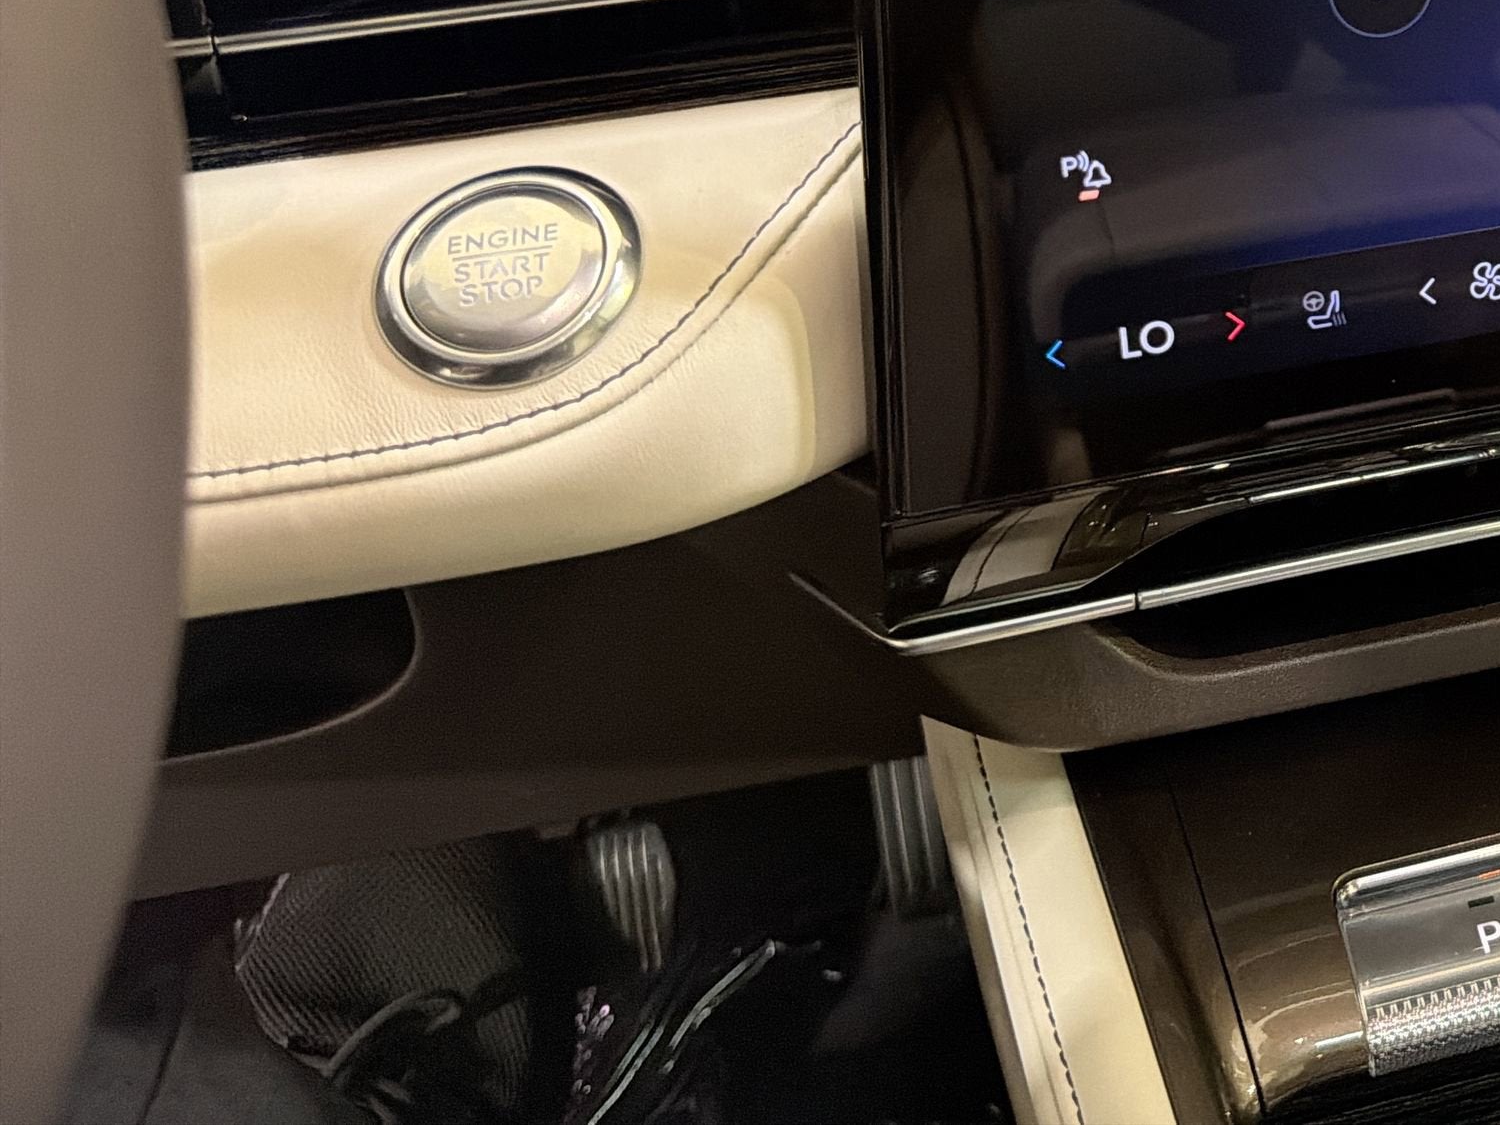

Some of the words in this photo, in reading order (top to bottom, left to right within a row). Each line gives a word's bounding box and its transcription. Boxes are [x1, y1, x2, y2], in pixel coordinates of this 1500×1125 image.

[447, 222, 559, 256] ENGINE
[454, 251, 551, 284] START
[459, 275, 545, 308] STOP
[1118, 319, 1175, 360] LO
